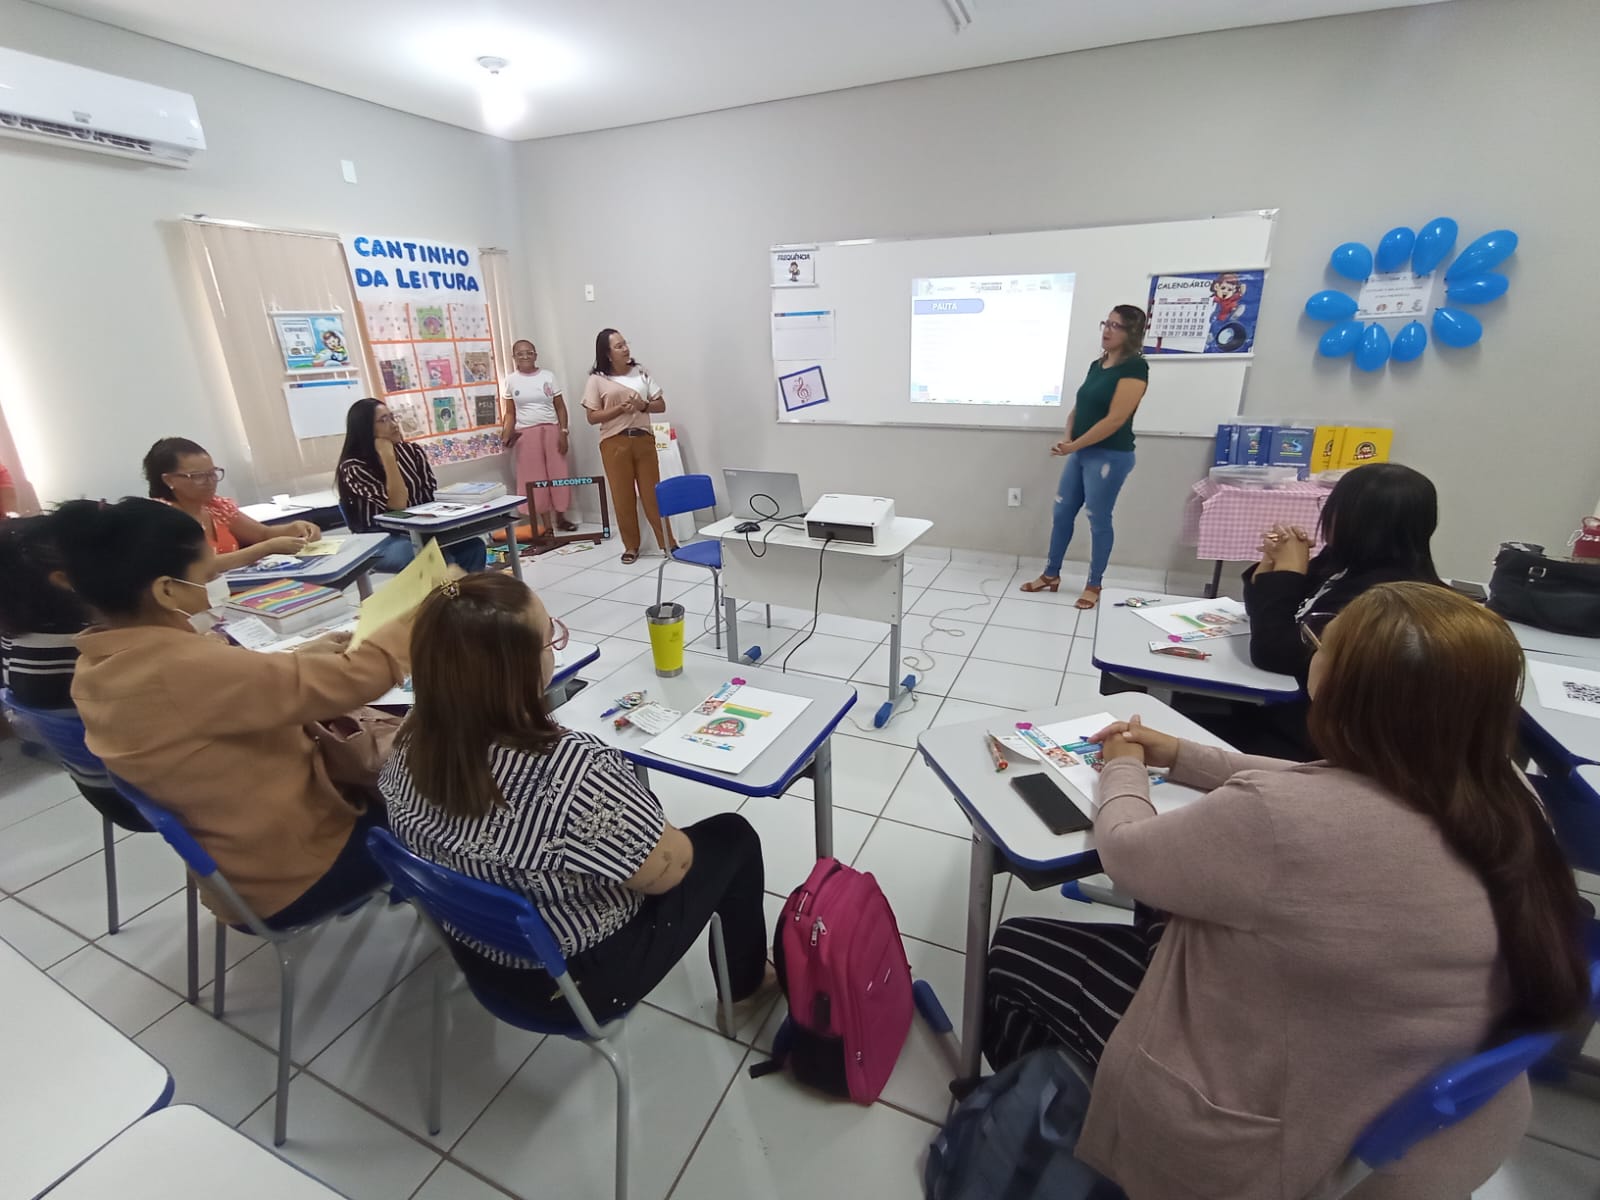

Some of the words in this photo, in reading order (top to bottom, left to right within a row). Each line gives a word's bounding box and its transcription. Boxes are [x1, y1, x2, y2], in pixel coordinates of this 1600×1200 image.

[354, 236, 469, 266] CANTINHO
[355, 268, 389, 287] DA
[395, 268, 479, 292] LEITURA
[1157, 280, 1211, 290] CALENDÁRIO
[932, 303, 957, 311] PAUTA
[535, 480, 548, 488] TV
[552, 477, 593, 487] RECONTO
